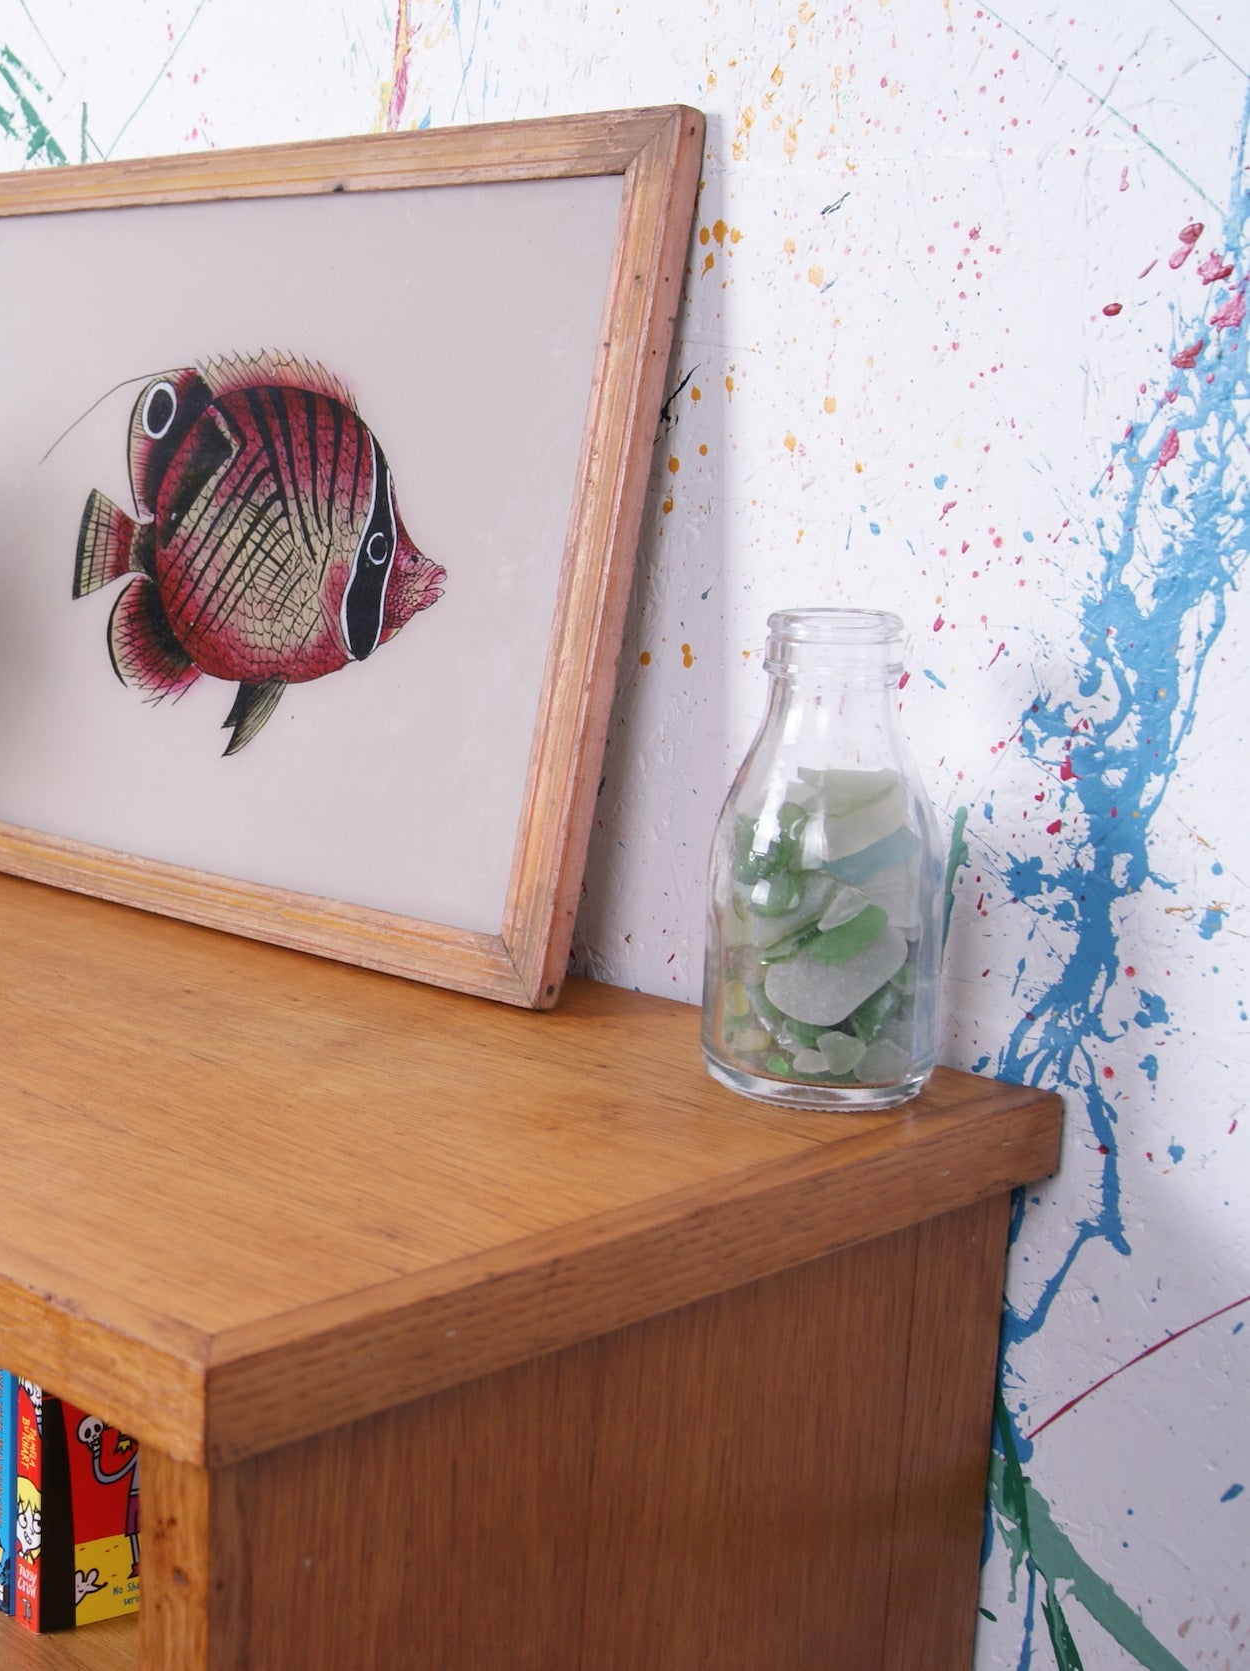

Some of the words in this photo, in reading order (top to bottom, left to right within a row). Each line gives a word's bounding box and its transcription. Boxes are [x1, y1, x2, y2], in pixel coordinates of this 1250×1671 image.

[21, 1416, 32, 1470] BUTCHART
[28, 1428, 38, 1468] PAMELA
[112, 1586, 124, 1596] No
